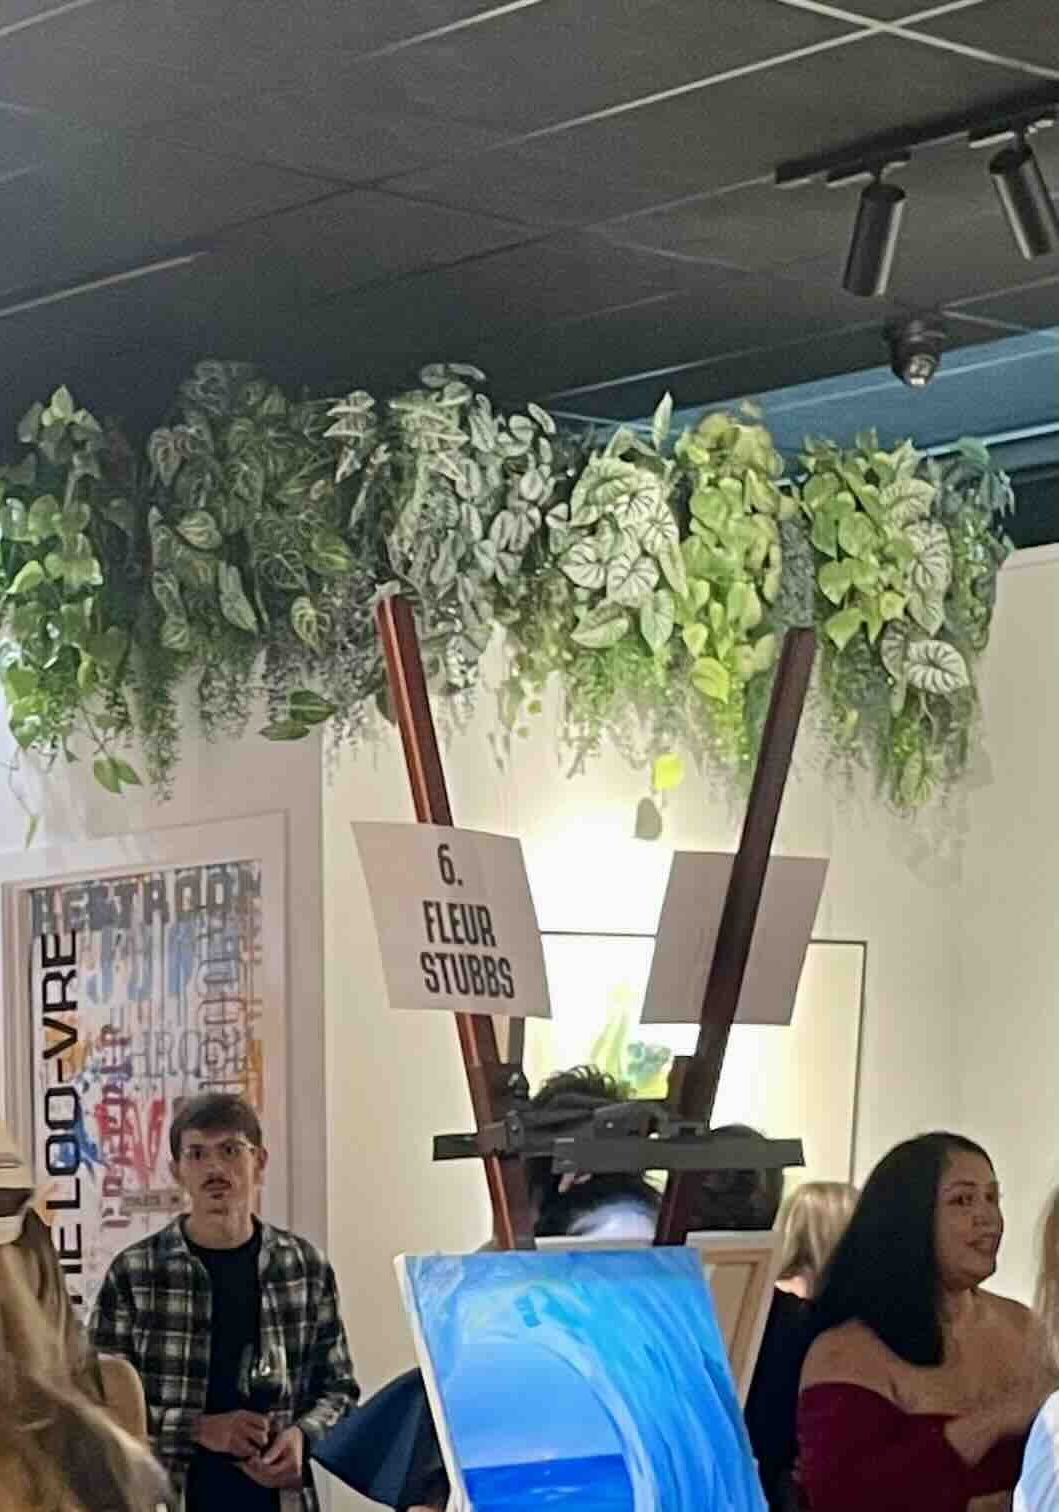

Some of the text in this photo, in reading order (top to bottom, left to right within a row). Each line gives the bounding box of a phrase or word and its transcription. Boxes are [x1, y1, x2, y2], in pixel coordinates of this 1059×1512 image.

[437, 843, 463, 887] 6.
[422, 899, 498, 948] FLEUR
[419, 951, 515, 999] STUBBS
[41, 929, 81, 1210] LOO-VRE
